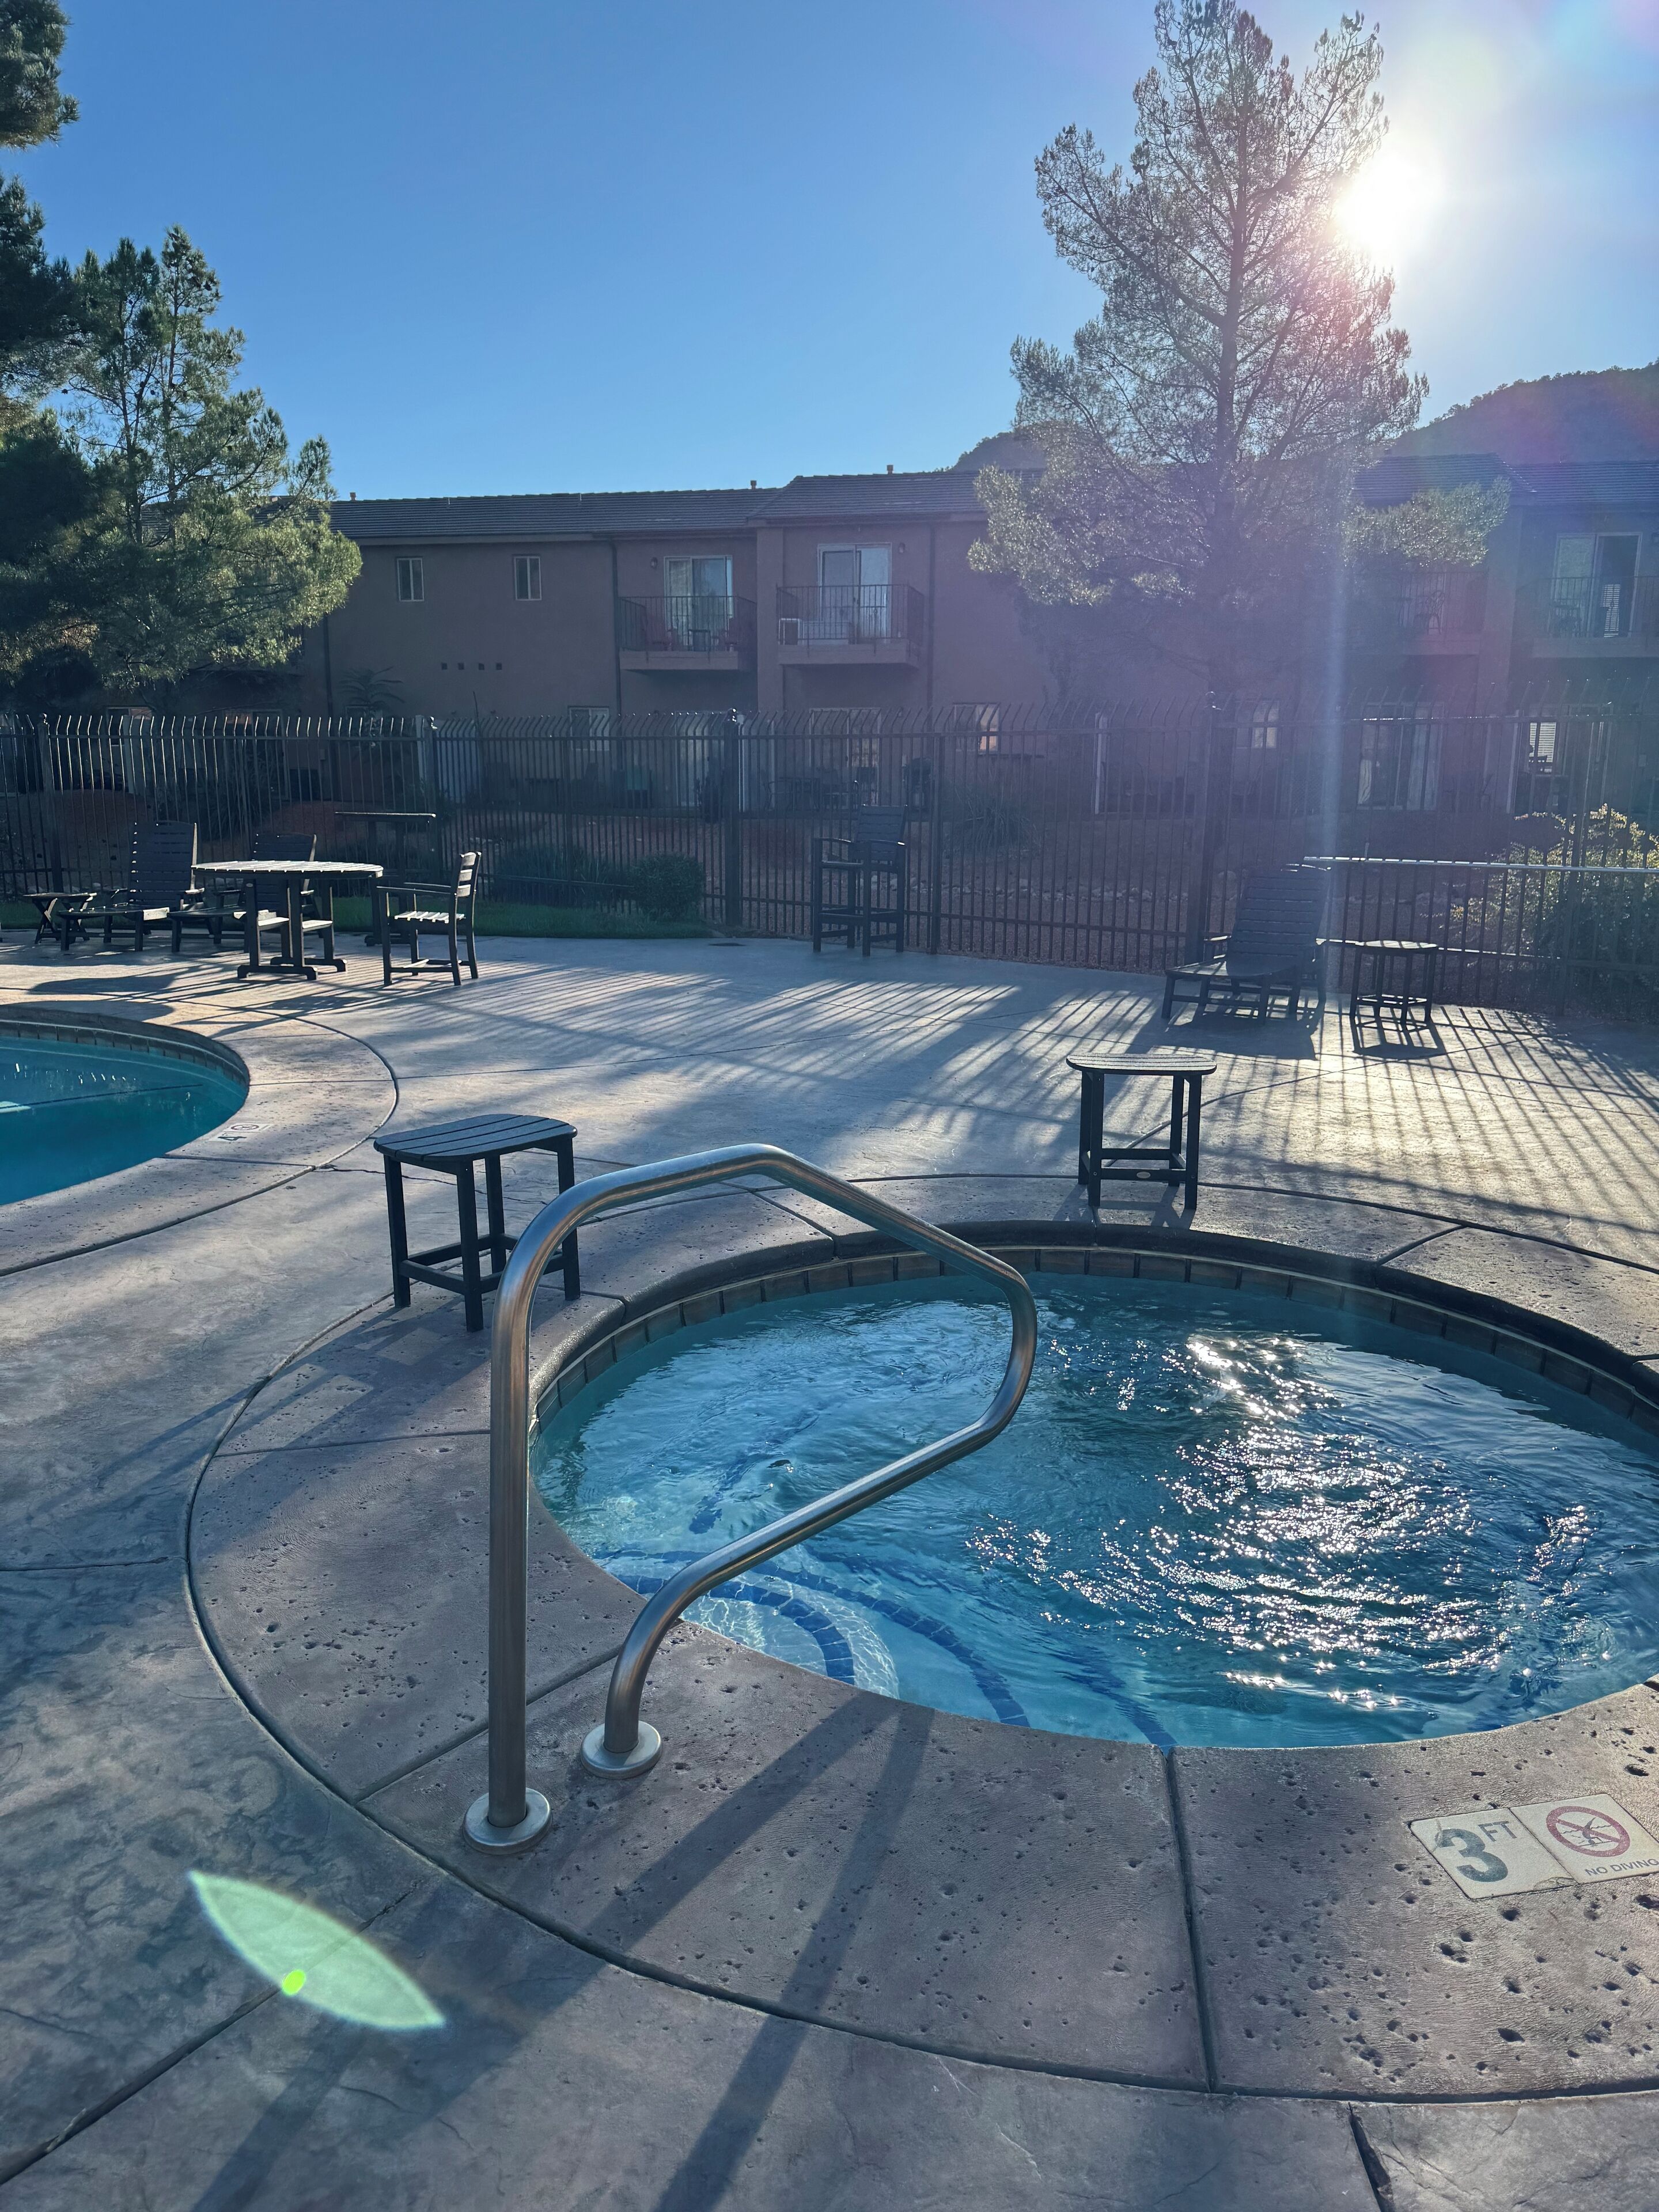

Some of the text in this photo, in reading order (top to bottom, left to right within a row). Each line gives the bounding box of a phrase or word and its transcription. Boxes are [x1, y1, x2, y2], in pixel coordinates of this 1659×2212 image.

[1434, 1820, 1517, 1883] 3 FT
[1585, 1858, 1659, 1876] NO DIVING
